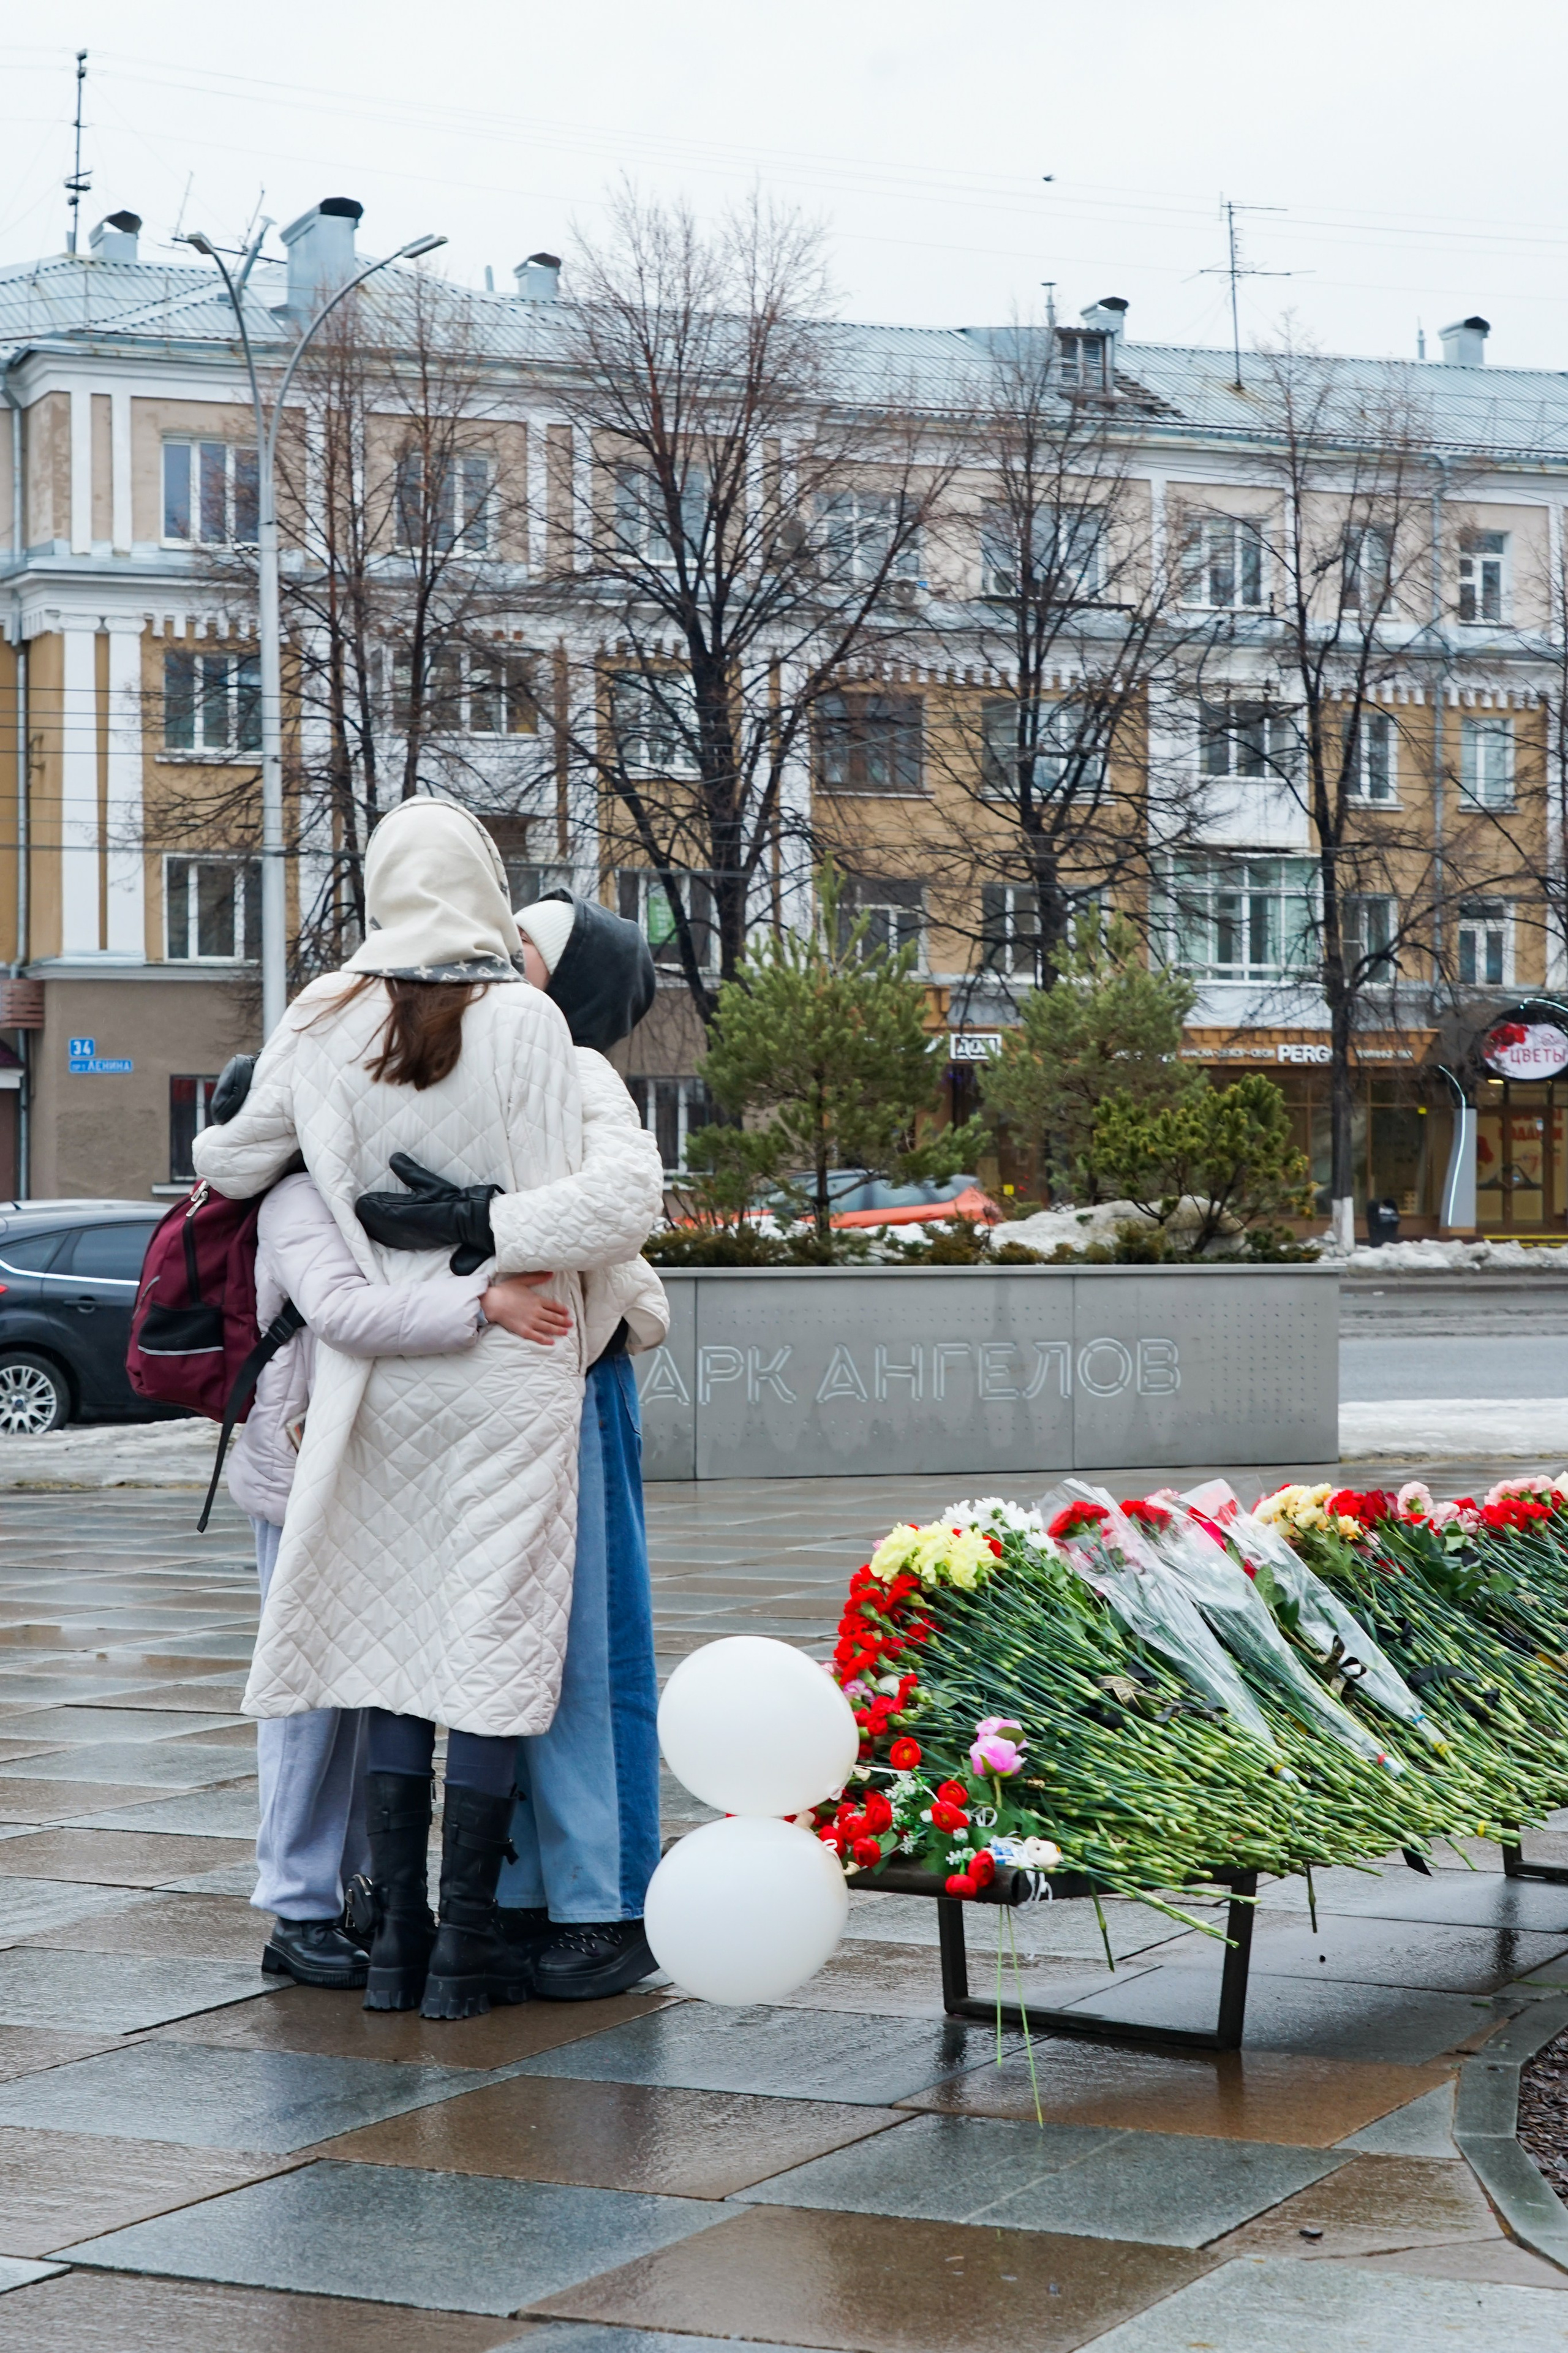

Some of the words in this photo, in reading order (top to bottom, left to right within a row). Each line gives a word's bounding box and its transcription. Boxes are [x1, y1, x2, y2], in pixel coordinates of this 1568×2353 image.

[73, 1040, 91, 1055] 34
[1278, 1044, 1333, 1063] PERG
[1510, 1048, 1566, 1065] ЦВЕТЫ
[88, 1060, 130, 1071] ЛЕНИНА
[638, 1345, 797, 1406] АРК
[815, 1336, 1182, 1404] АНГЕЛОВ
